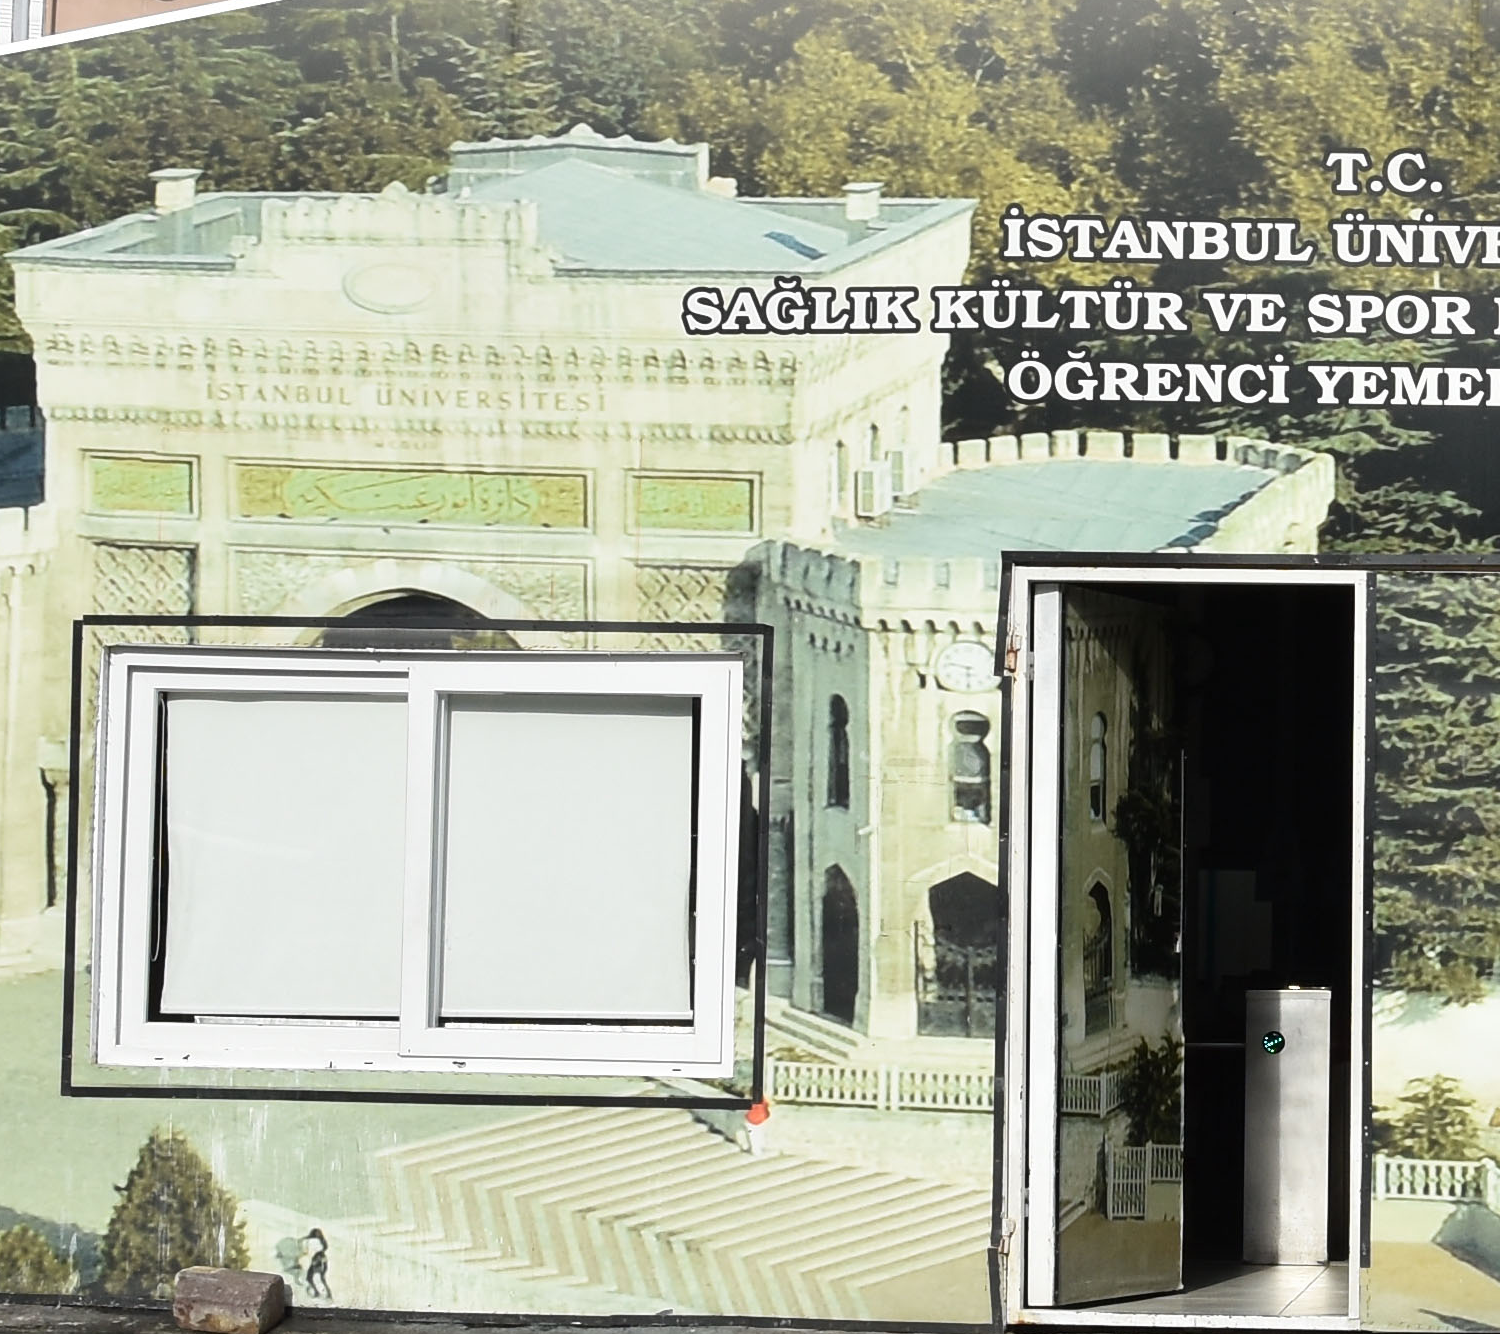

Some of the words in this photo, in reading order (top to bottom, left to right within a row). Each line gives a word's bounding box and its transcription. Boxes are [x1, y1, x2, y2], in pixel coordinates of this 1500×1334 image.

[1325, 150, 1444, 194] T.C.
[1002, 207, 1313, 262] İSTANBUL
[684, 279, 922, 333] SAĞLIK
[931, 280, 1189, 332] KÜLTÜR
[1203, 292, 1287, 333] VE
[1306, 292, 1476, 337] SPOR
[206, 382, 352, 406] İSTANBUL
[1007, 350, 1291, 404] ÖĞRENCİ
